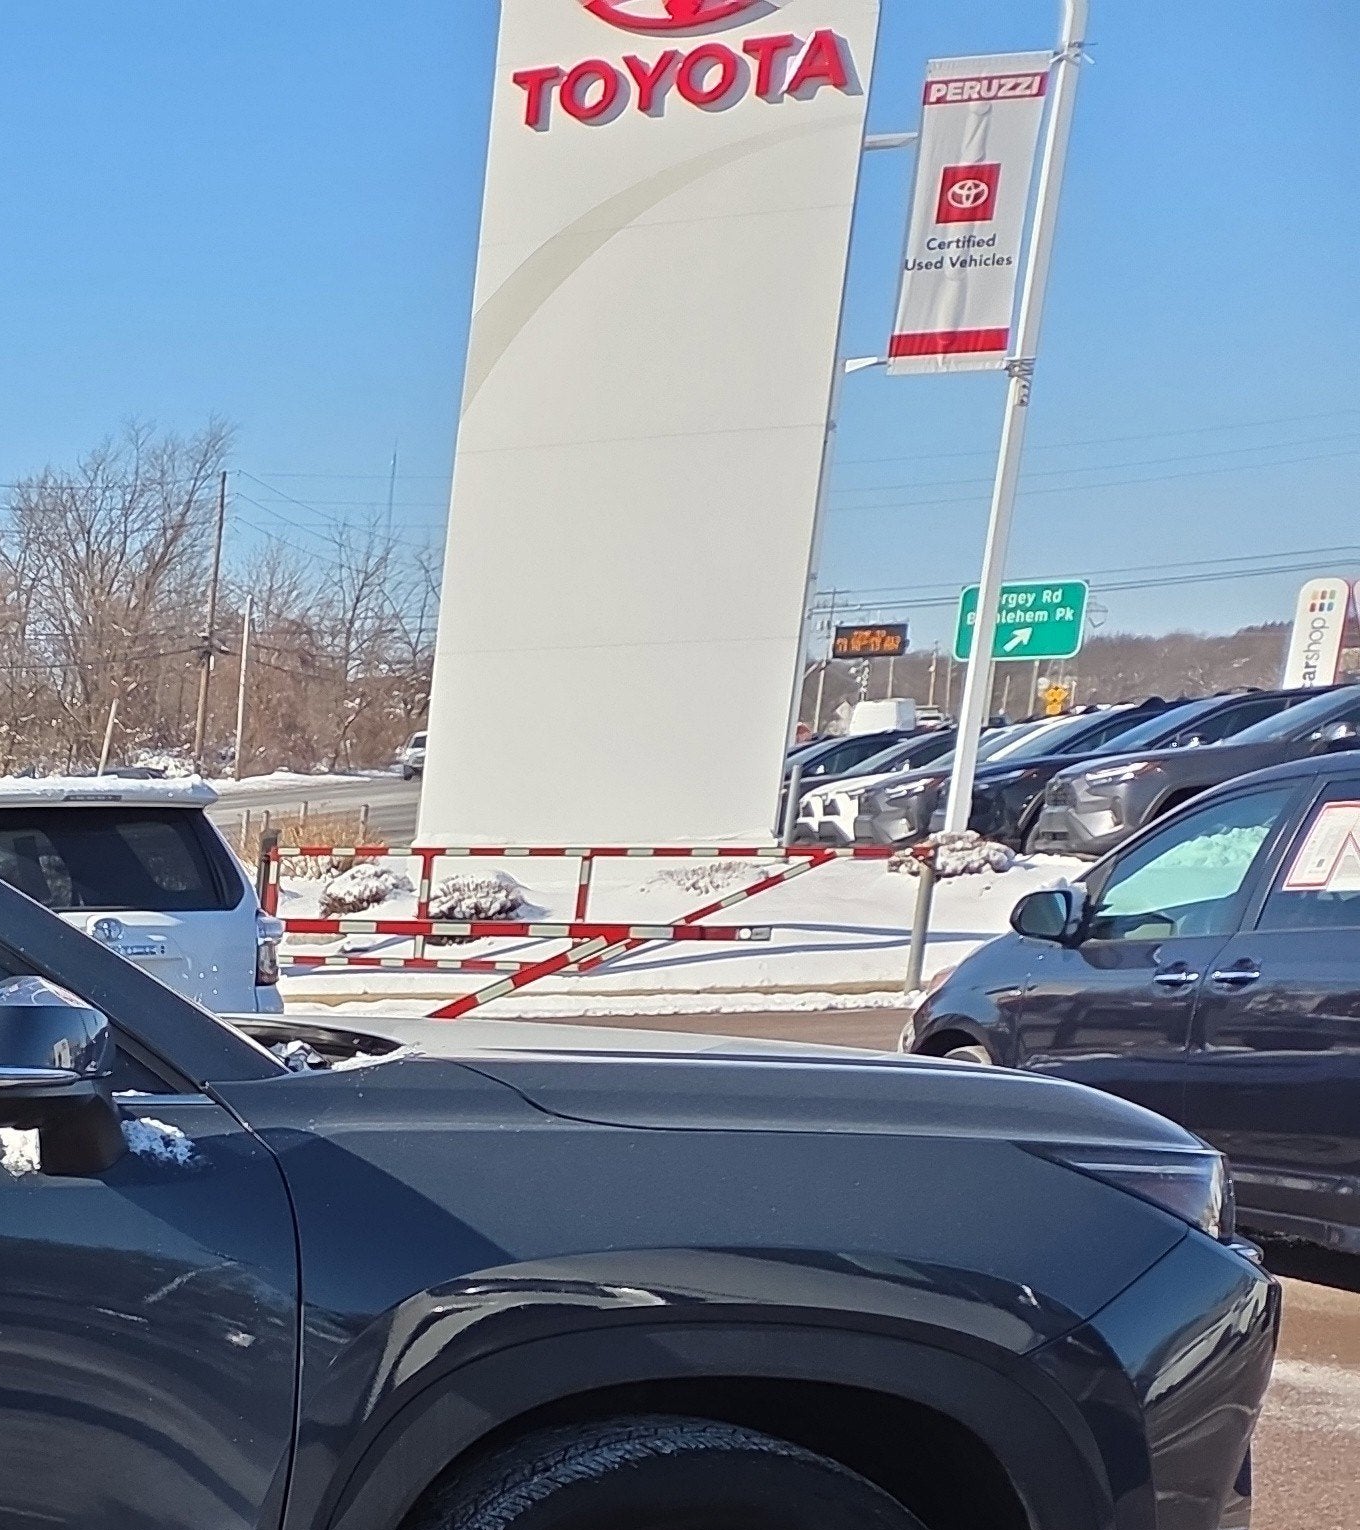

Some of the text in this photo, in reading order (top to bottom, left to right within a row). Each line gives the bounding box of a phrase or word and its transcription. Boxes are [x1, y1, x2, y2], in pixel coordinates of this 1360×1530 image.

[512, 29, 848, 127] TOYOTA
[929, 75, 1041, 103] PERUZZI
[926, 233, 997, 251] Certified
[904, 253, 1013, 271] Used Vehicles
[1042, 589, 1063, 604] Rd
[1055, 607, 1075, 621] Pk
